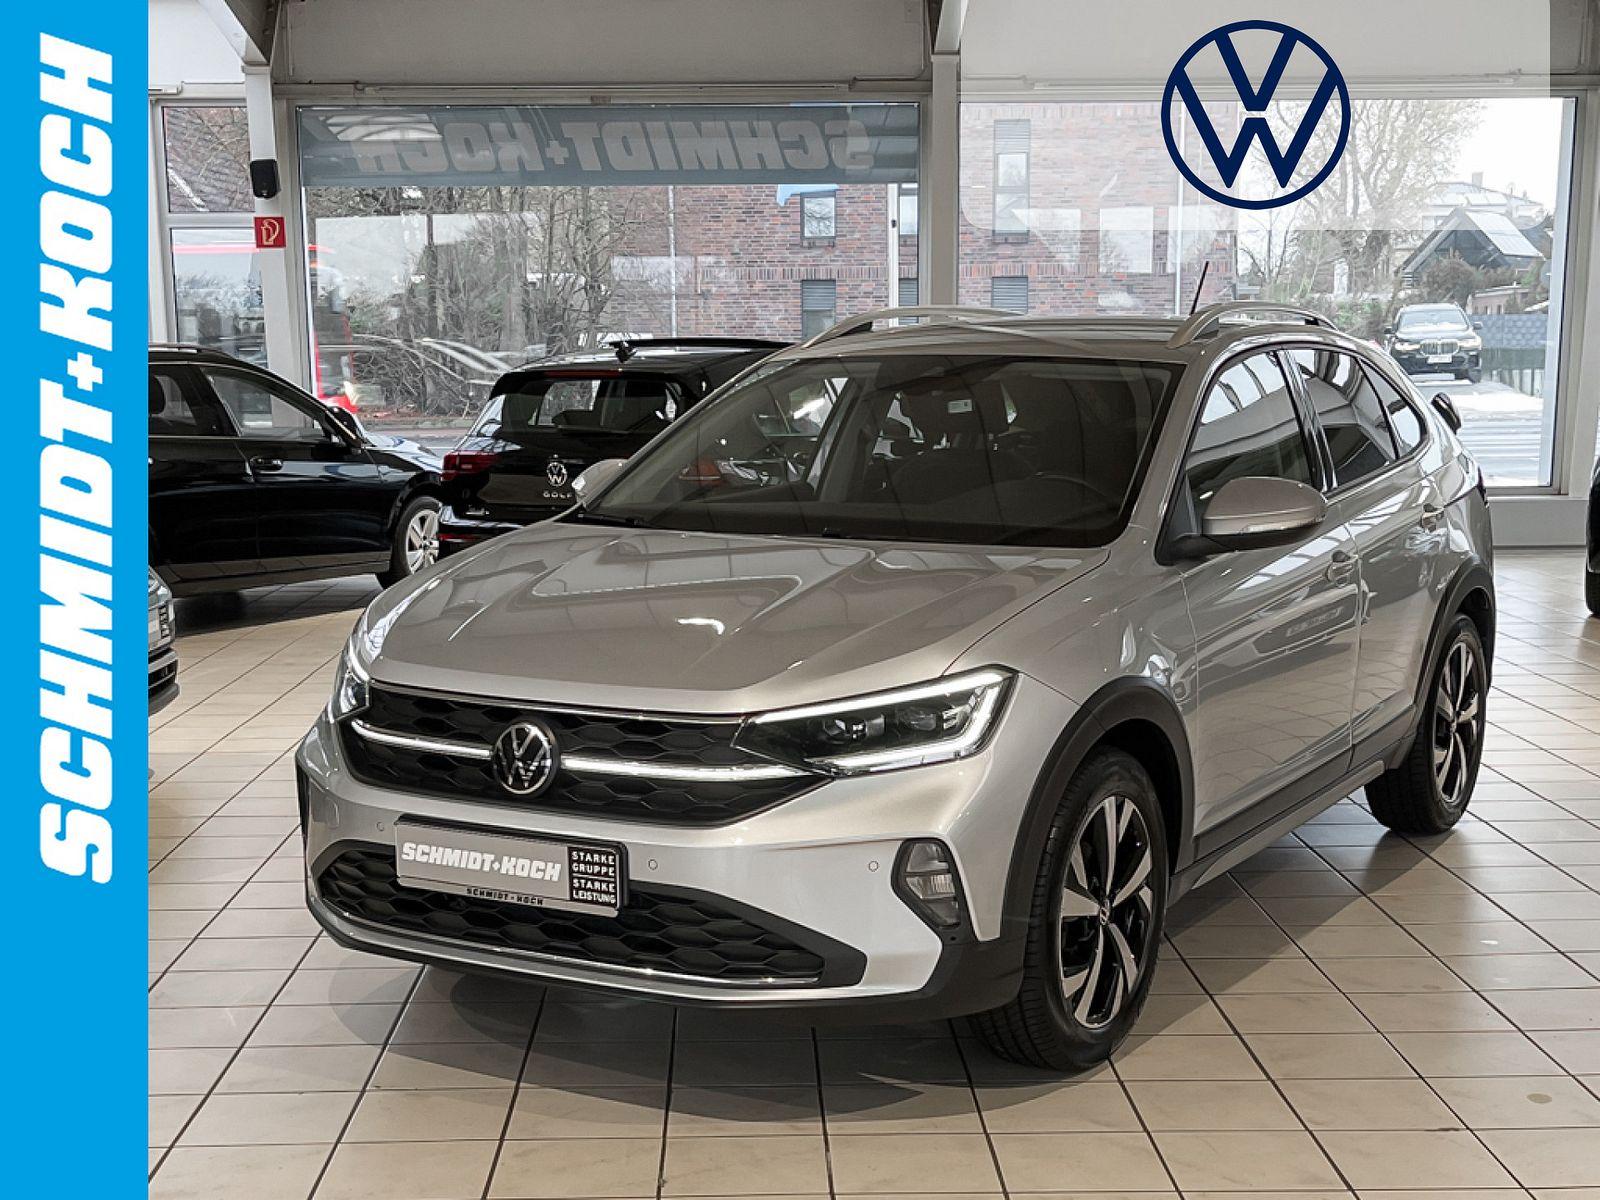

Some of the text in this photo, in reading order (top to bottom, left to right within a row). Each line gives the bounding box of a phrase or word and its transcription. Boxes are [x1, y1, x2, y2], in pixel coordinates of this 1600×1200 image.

[542, 490, 573, 499] GOLF
[401, 841, 562, 882] SCHMIDT+KOCH
[571, 851, 615, 865] STARKE
[572, 862, 615, 876] GRUPPE
[572, 878, 616, 892] STARKE
[572, 889, 616, 904] LEISTUNG
